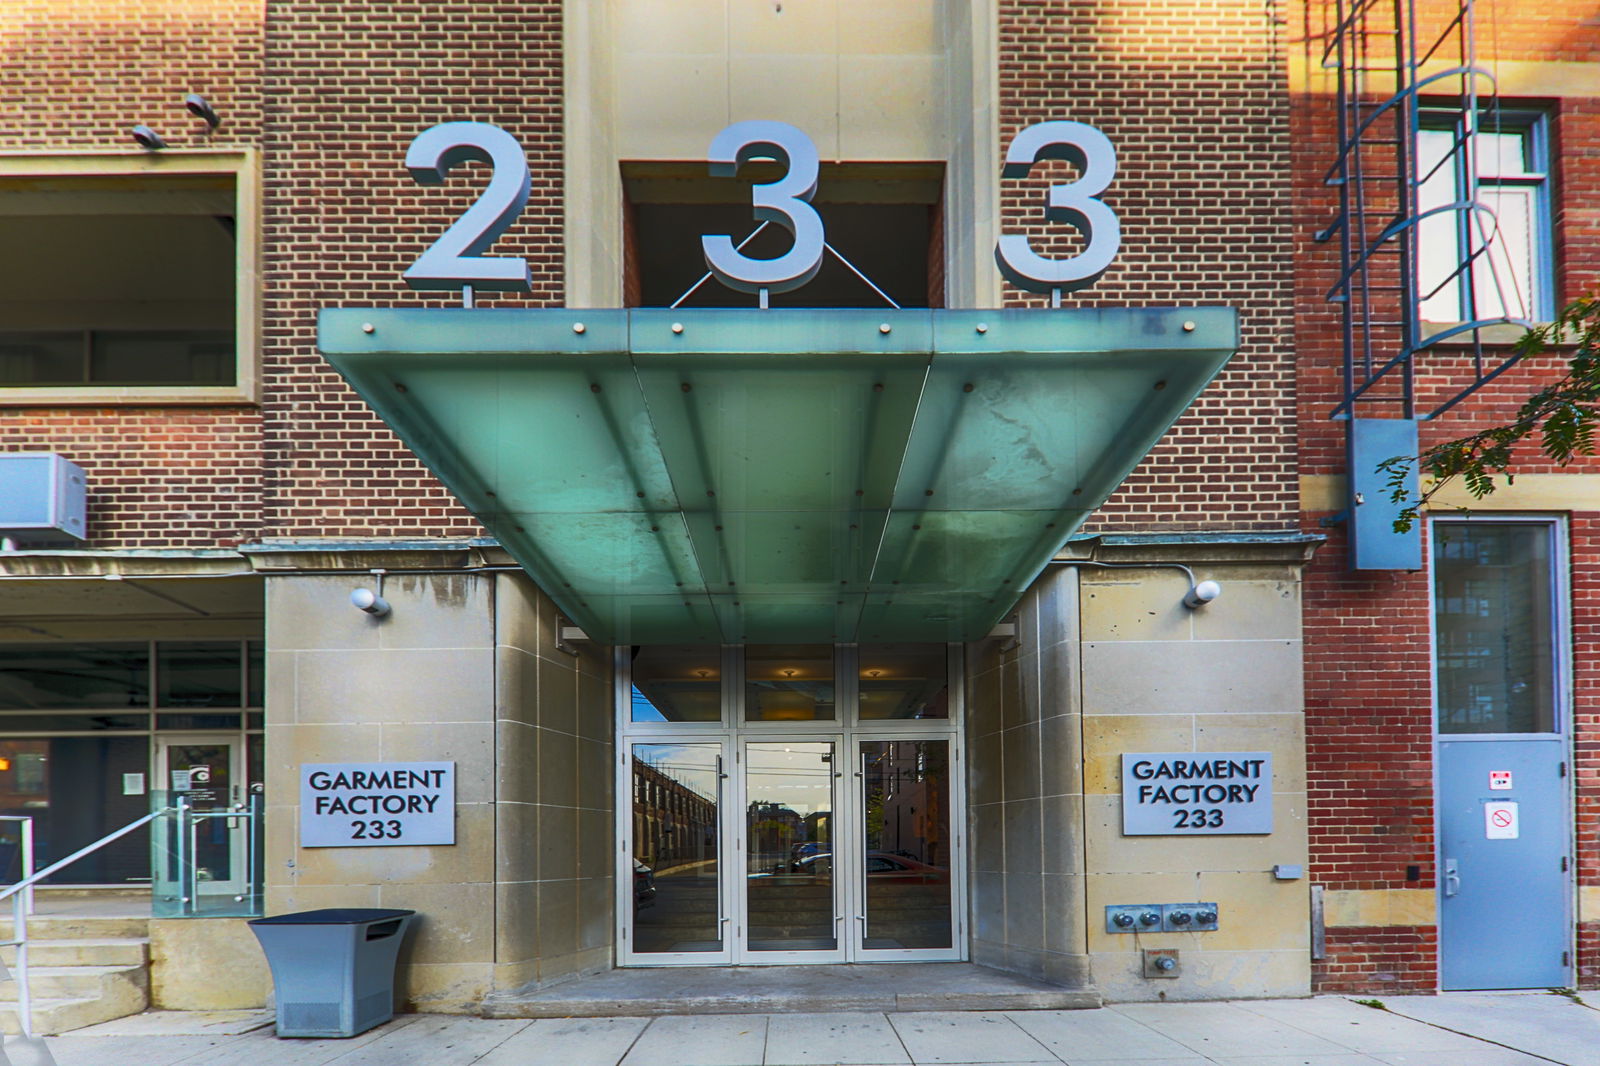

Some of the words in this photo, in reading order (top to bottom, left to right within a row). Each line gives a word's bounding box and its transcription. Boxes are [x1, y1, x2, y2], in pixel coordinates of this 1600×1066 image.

[1132, 760, 1264, 779] GARMENT
[309, 770, 446, 790] GARMENT
[1139, 784, 1259, 803] FACTORY
[315, 795, 440, 815] FACTORY
[1173, 809, 1224, 828] 233
[351, 820, 402, 840] 233
